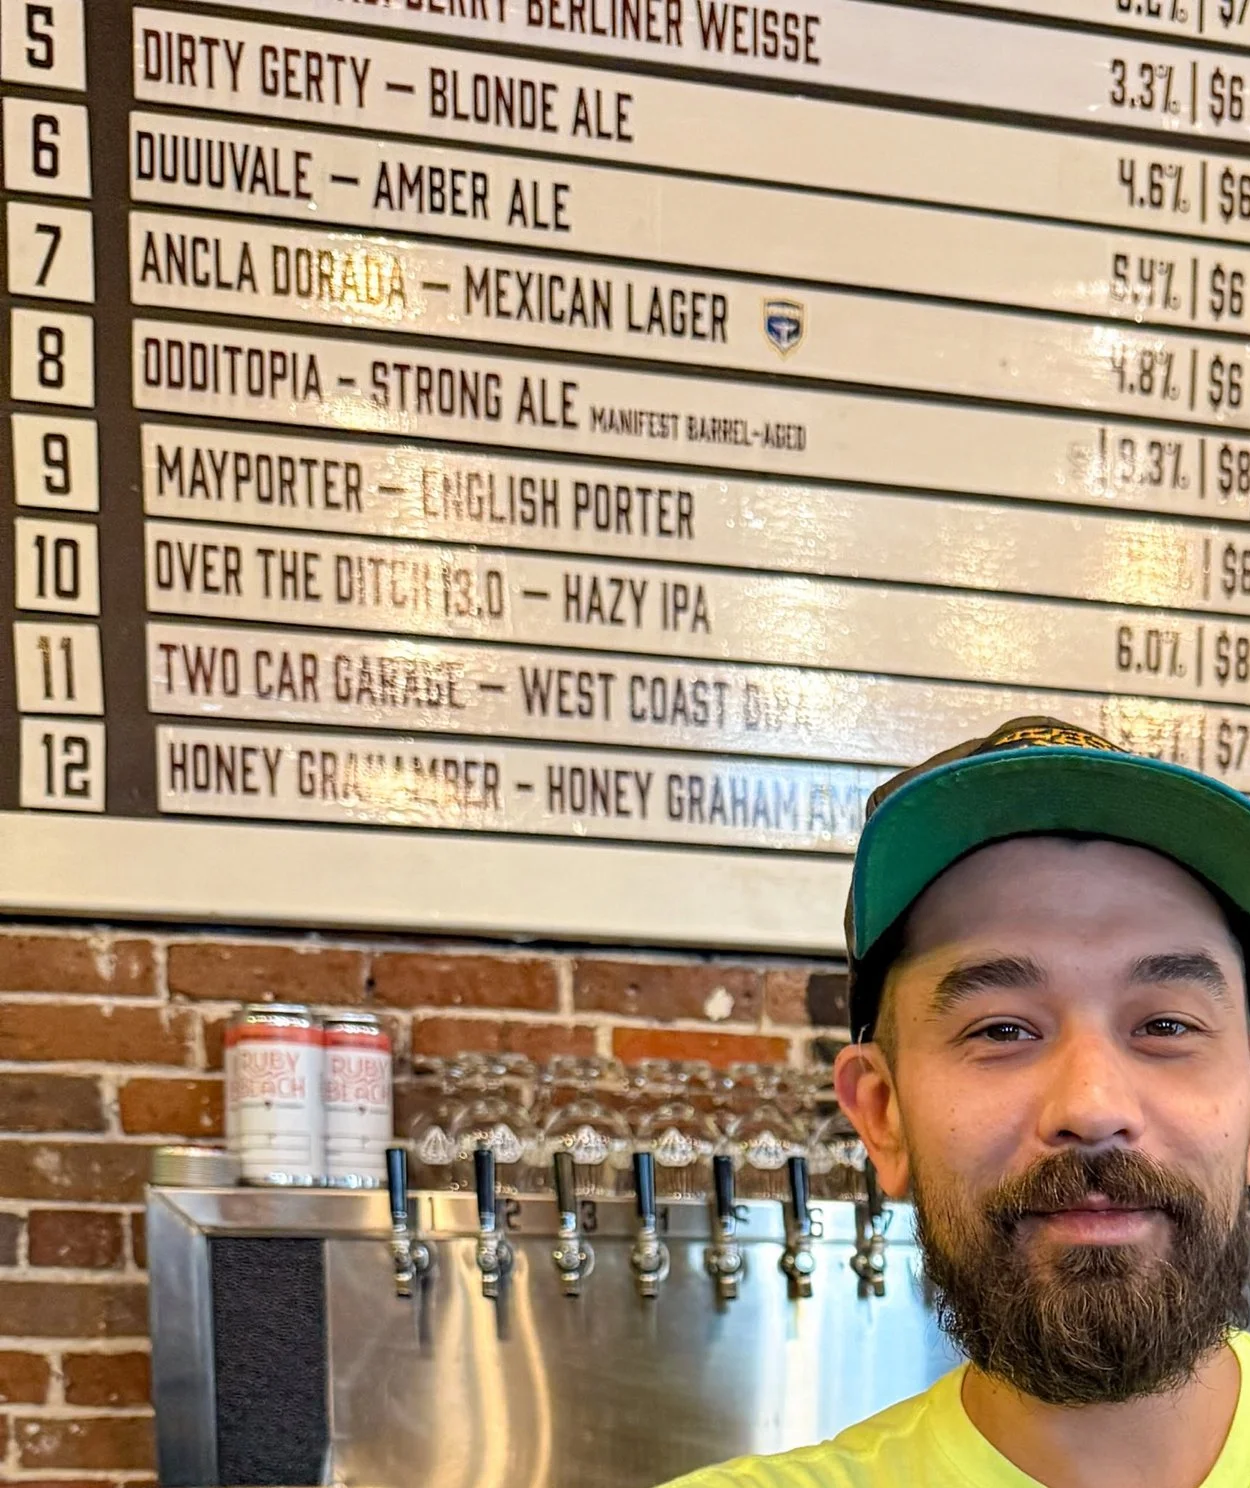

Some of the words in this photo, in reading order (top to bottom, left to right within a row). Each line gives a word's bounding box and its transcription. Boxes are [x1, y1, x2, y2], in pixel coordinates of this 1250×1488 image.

[25, 4, 54, 69] 5
[698, 2, 820, 65] WEISSE
[1109, 59, 1179, 116] 3.3%
[1209, 67, 1246, 127] $6
[32, 114, 60, 178] 6
[143, 29, 245, 94] DIRTY
[261, 45, 371, 108] GERTY
[430, 67, 559, 131] BLONDE
[571, 87, 634, 142] ALE
[1116, 158, 1191, 215] 4.6%
[34, 224, 62, 287] 7
[136, 130, 313, 200] DUUUVALE
[373, 162, 489, 220] AMBER
[508, 178, 572, 233] ALE
[1209, 262, 1246, 320] $6
[38, 327, 64, 387] 8
[140, 231, 257, 294] ANCLA
[465, 264, 612, 331] MEXICAN
[627, 281, 729, 345] LAGER
[1209, 354, 1243, 412] $6
[144, 337, 323, 398] ODDITOPIA
[370, 360, 501, 419] STRONG
[517, 376, 579, 428] ALE
[589, 405, 679, 441] MANIFEST
[686, 414, 807, 451] BARREL-AGED
[1219, 444, 1250, 497] $8
[43, 433, 69, 495] 9
[156, 444, 363, 513] MAYPORTER
[422, 467, 558, 528] ENGLISH
[575, 481, 695, 541] PORTER
[34, 534, 80, 600] 10
[155, 539, 241, 597] OVER
[256, 548, 322, 602] THE
[565, 574, 648, 631] HAZY
[661, 583, 712, 635] IPA
[1216, 630, 1250, 687] $8
[38, 634, 76, 700] 11
[160, 643, 238, 697] TWO
[255, 650, 319, 704] CAR
[520, 666, 616, 721] WEST
[630, 675, 727, 728] COAST
[1217, 718, 1248, 773] $7
[43, 732, 91, 797] 12
[168, 741, 284, 799] HONEY
[547, 765, 653, 820] HONEY
[667, 773, 800, 830] GRAHAM
